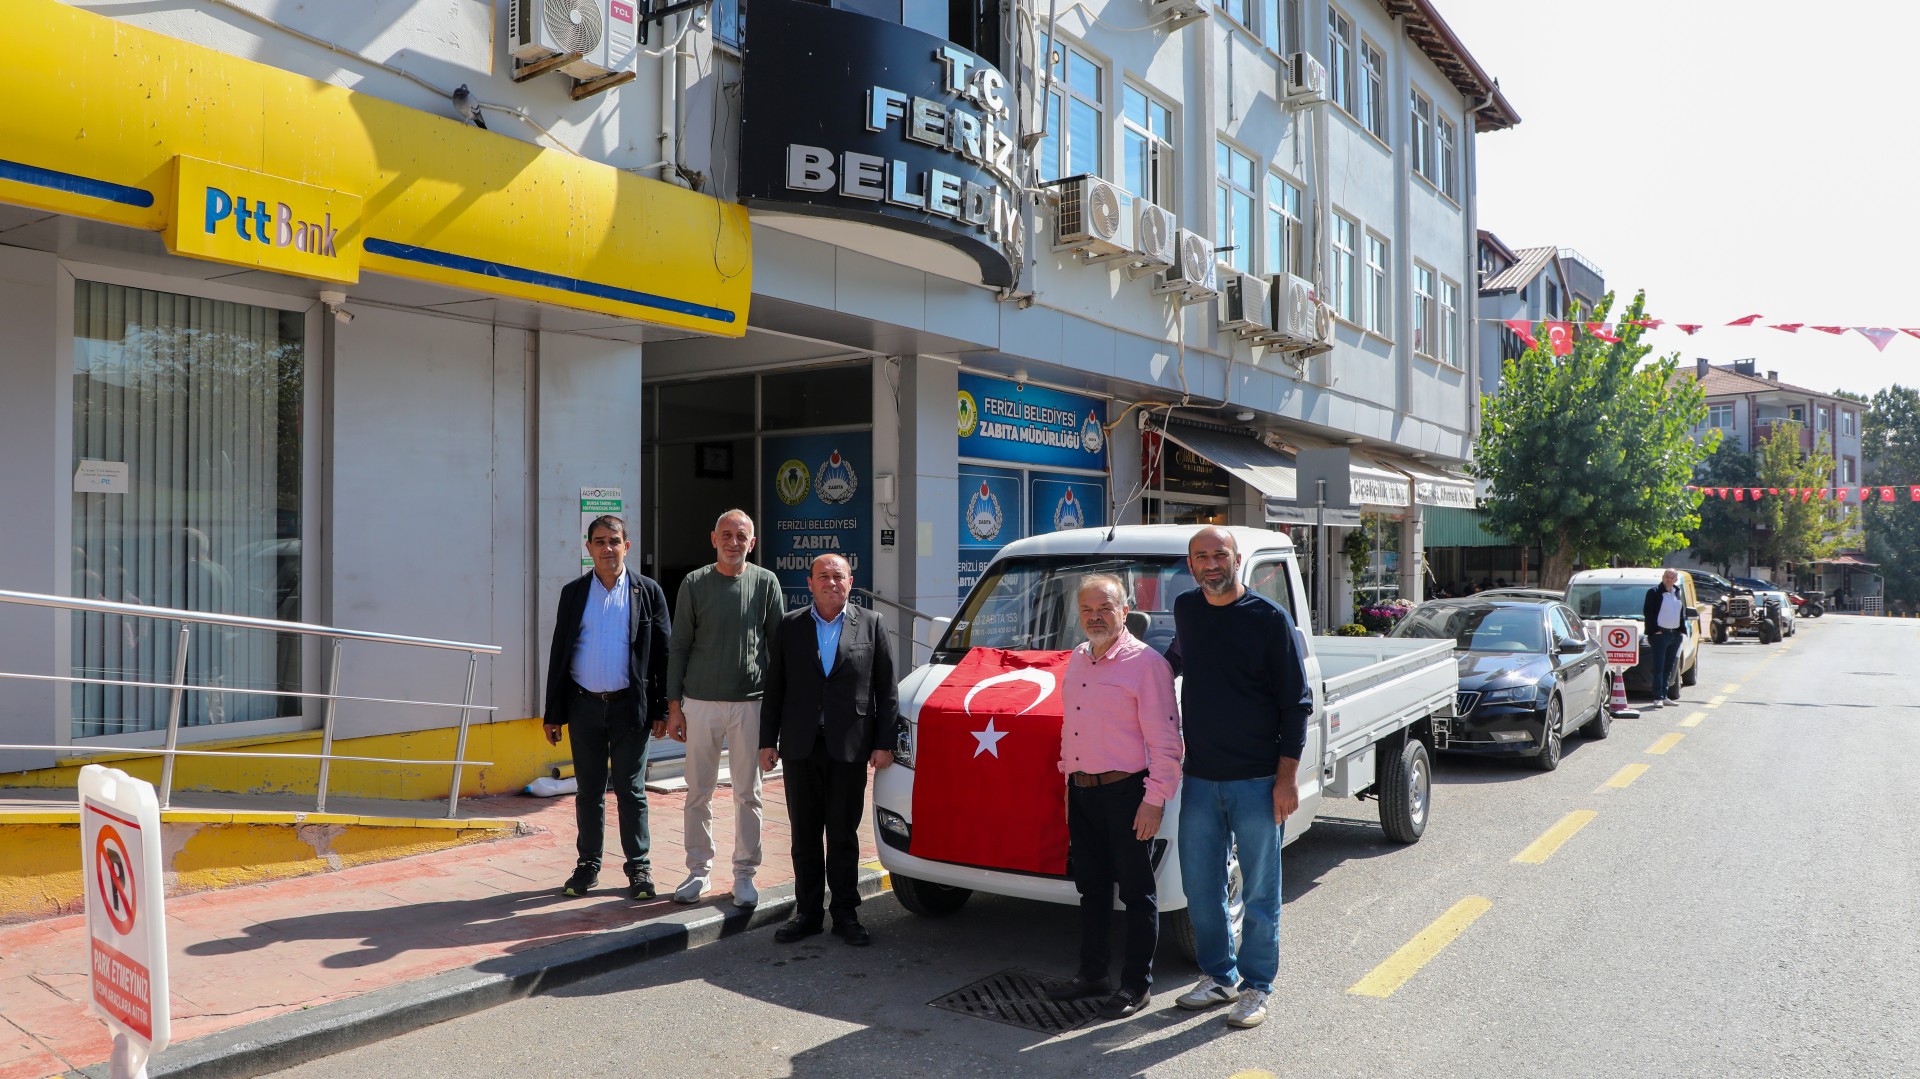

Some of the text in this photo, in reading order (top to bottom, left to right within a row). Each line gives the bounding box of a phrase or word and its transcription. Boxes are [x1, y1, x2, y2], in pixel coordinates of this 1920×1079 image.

[613, 6, 630, 18] TCL
[866, 85, 1022, 191] FERİZL
[984, 397, 1076, 427] FERİZLİ BELEDİYESİ
[979, 421, 1080, 449] ZABITA MÜDÜRLÜĞÜ
[777, 517, 857, 530] FERİZLİ BELEDİYESİ
[793, 535, 841, 550] ZABITA
[958, 559, 978, 573] ERİZLİ
[790, 593, 809, 606] ALO
[94, 948, 148, 1004] PARK ETMEYİNİZ
